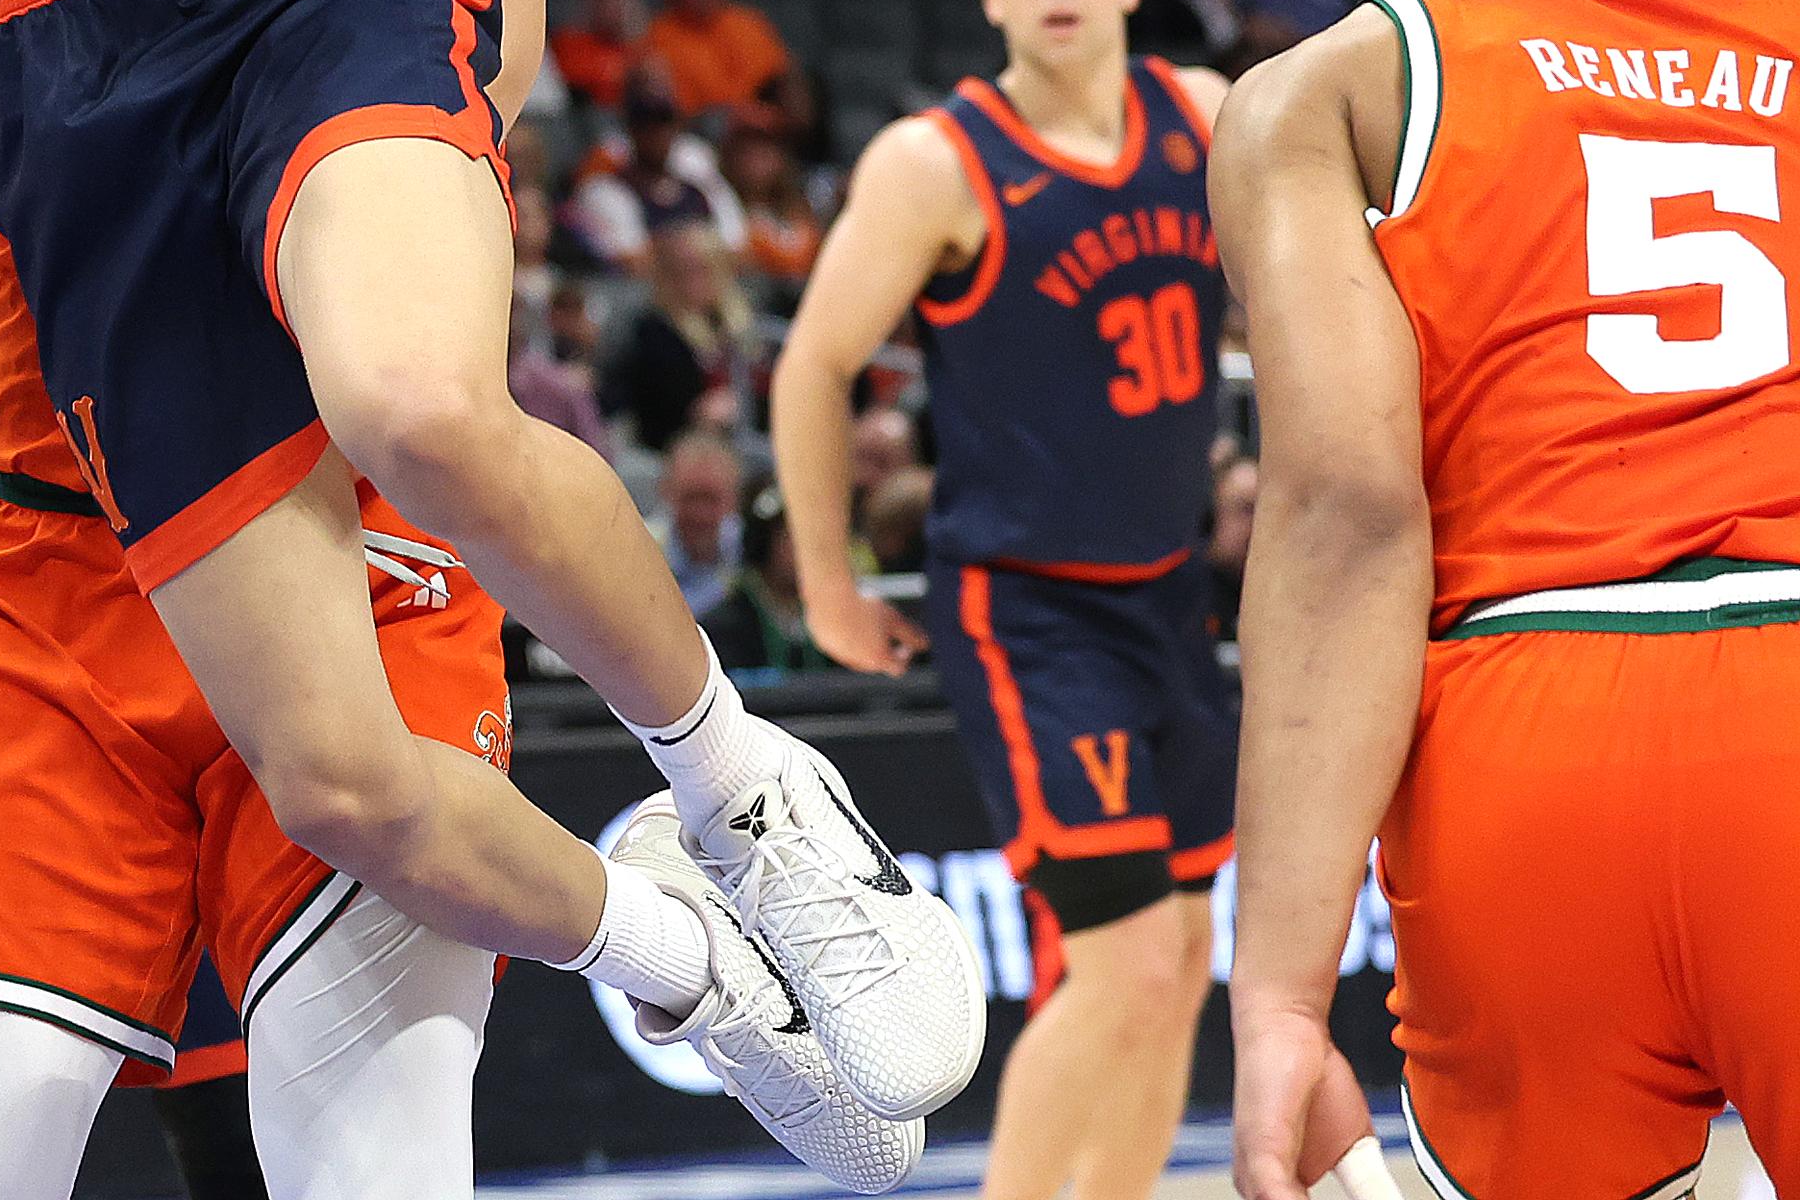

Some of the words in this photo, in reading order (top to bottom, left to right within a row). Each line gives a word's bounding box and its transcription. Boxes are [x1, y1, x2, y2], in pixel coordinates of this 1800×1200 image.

[1518, 38, 1794, 118] RENEAU
[1578, 132, 1791, 395] 5
[1096, 279, 1205, 418] 30
[1070, 729, 1132, 816] V
